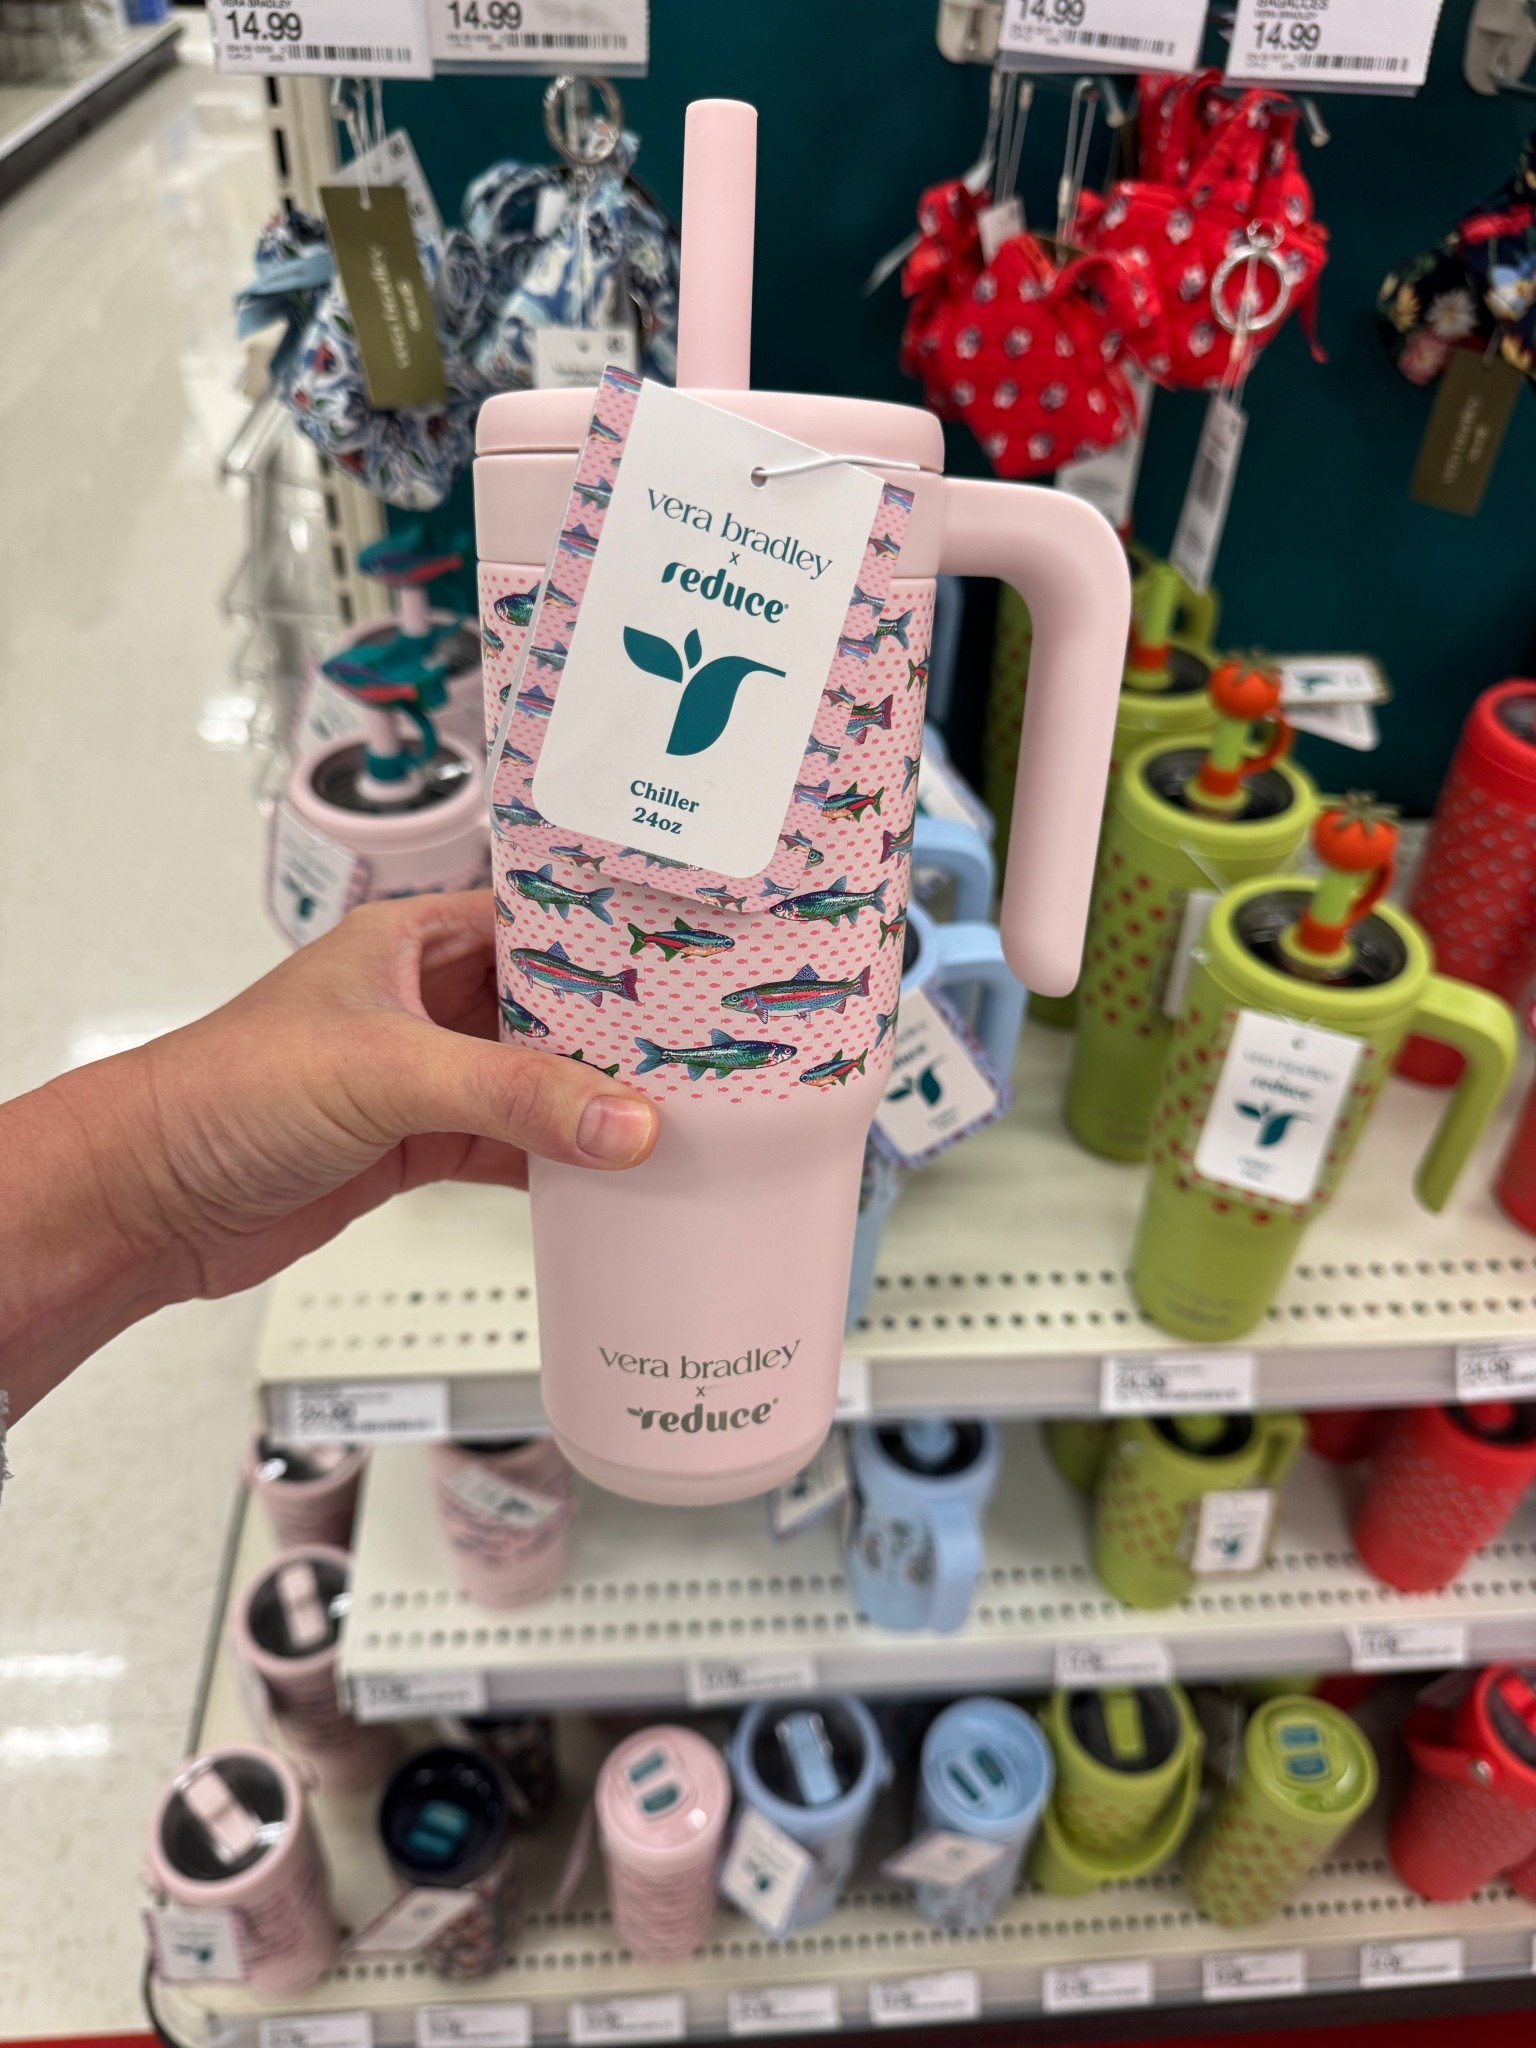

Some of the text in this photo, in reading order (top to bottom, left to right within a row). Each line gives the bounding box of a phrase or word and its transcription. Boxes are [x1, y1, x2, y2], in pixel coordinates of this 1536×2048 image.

[225, 10, 303, 41] 14.99
[446, 0, 523, 30] 14.99
[1018, 0, 1086, 28] 14.99
[1254, 21, 1321, 51] 14.99
[648, 488, 834, 580] vera bradley
[729, 551, 741, 566] x
[630, 779, 700, 813] Chiller
[632, 806, 683, 835] 24oz
[598, 1339, 801, 1379] vera bradley
[695, 1386, 706, 1397] x
